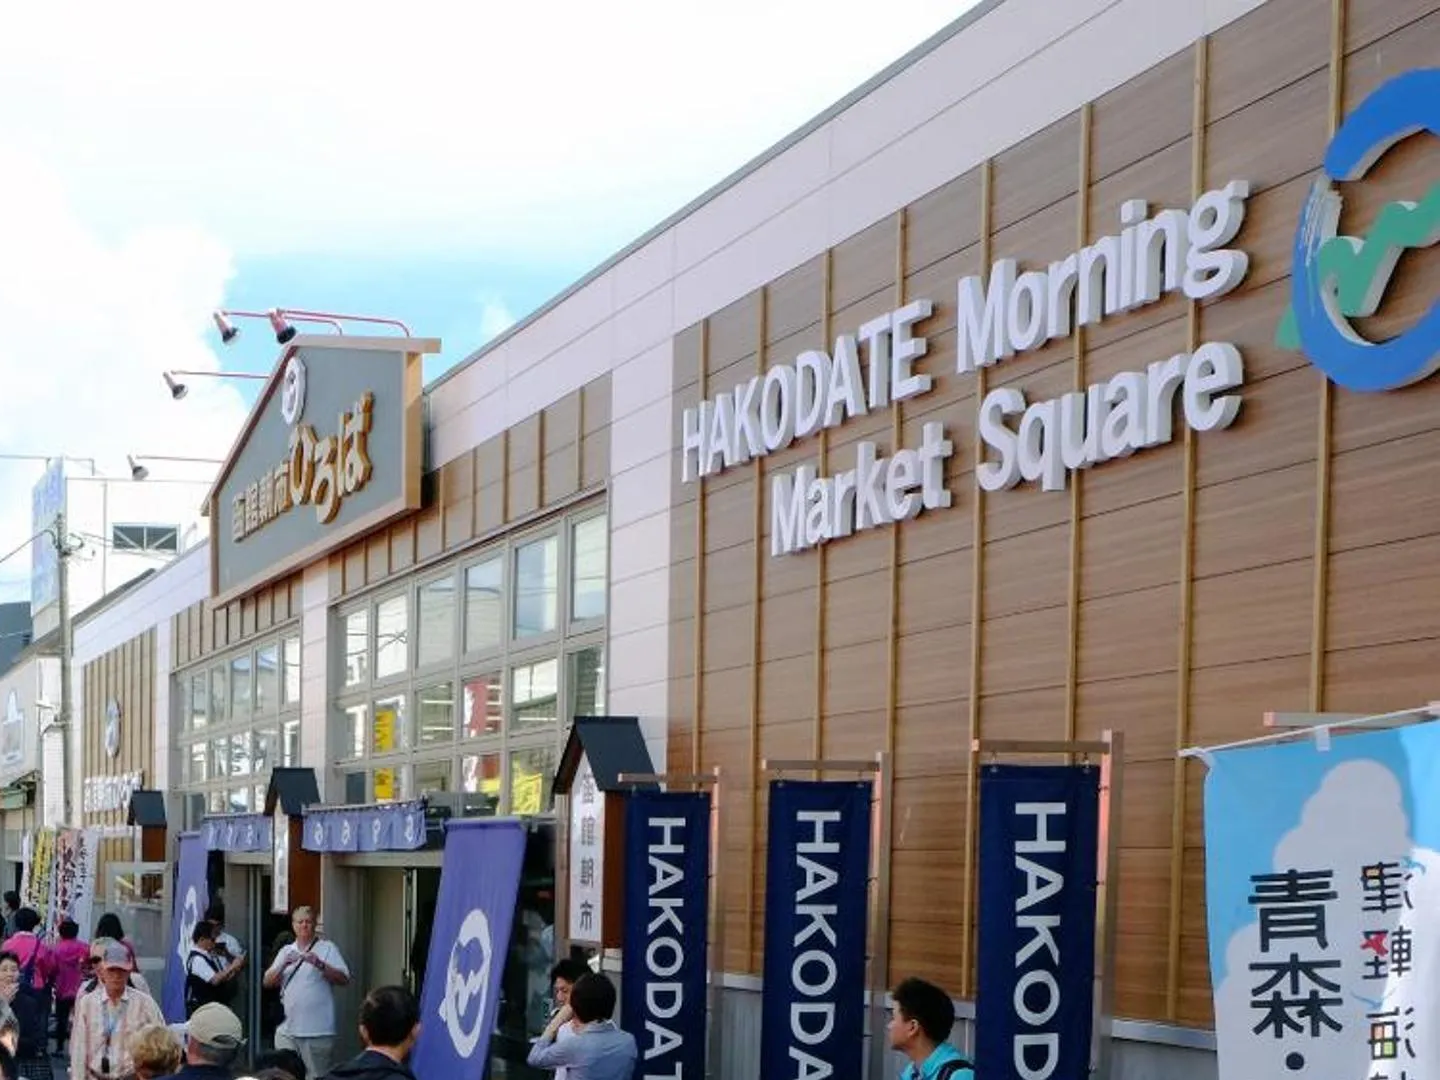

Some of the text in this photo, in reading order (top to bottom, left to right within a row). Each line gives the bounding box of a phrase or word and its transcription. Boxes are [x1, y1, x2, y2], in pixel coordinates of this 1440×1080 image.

[681, 179, 1250, 483] HAKODATE Morning
[770, 341, 1244, 558] Market Square
